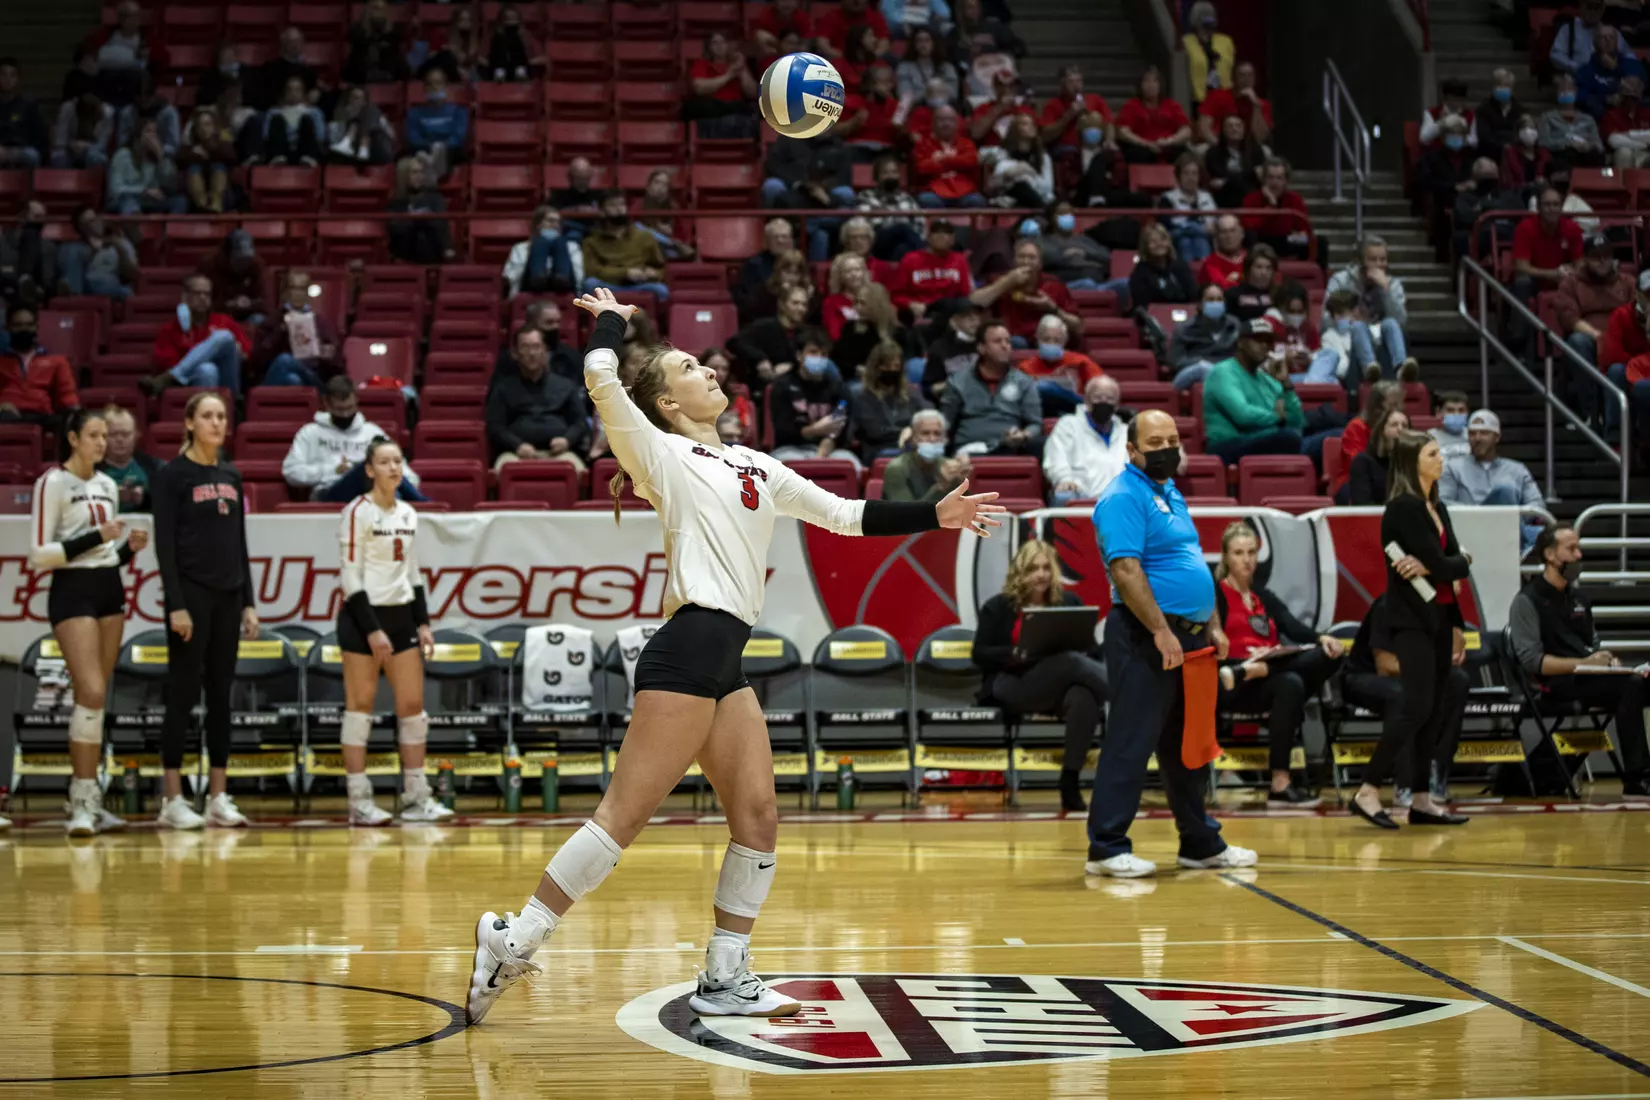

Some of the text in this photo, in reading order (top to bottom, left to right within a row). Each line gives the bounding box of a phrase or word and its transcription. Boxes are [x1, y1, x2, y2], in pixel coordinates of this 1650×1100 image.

[738, 472, 760, 511] 3
[392, 537, 405, 562] 2
[453, 715, 488, 724] STATE
[523, 713, 588, 723] BALL STATE
[831, 711, 896, 721] BALL STATE
[931, 710, 995, 720] BALL STATE
